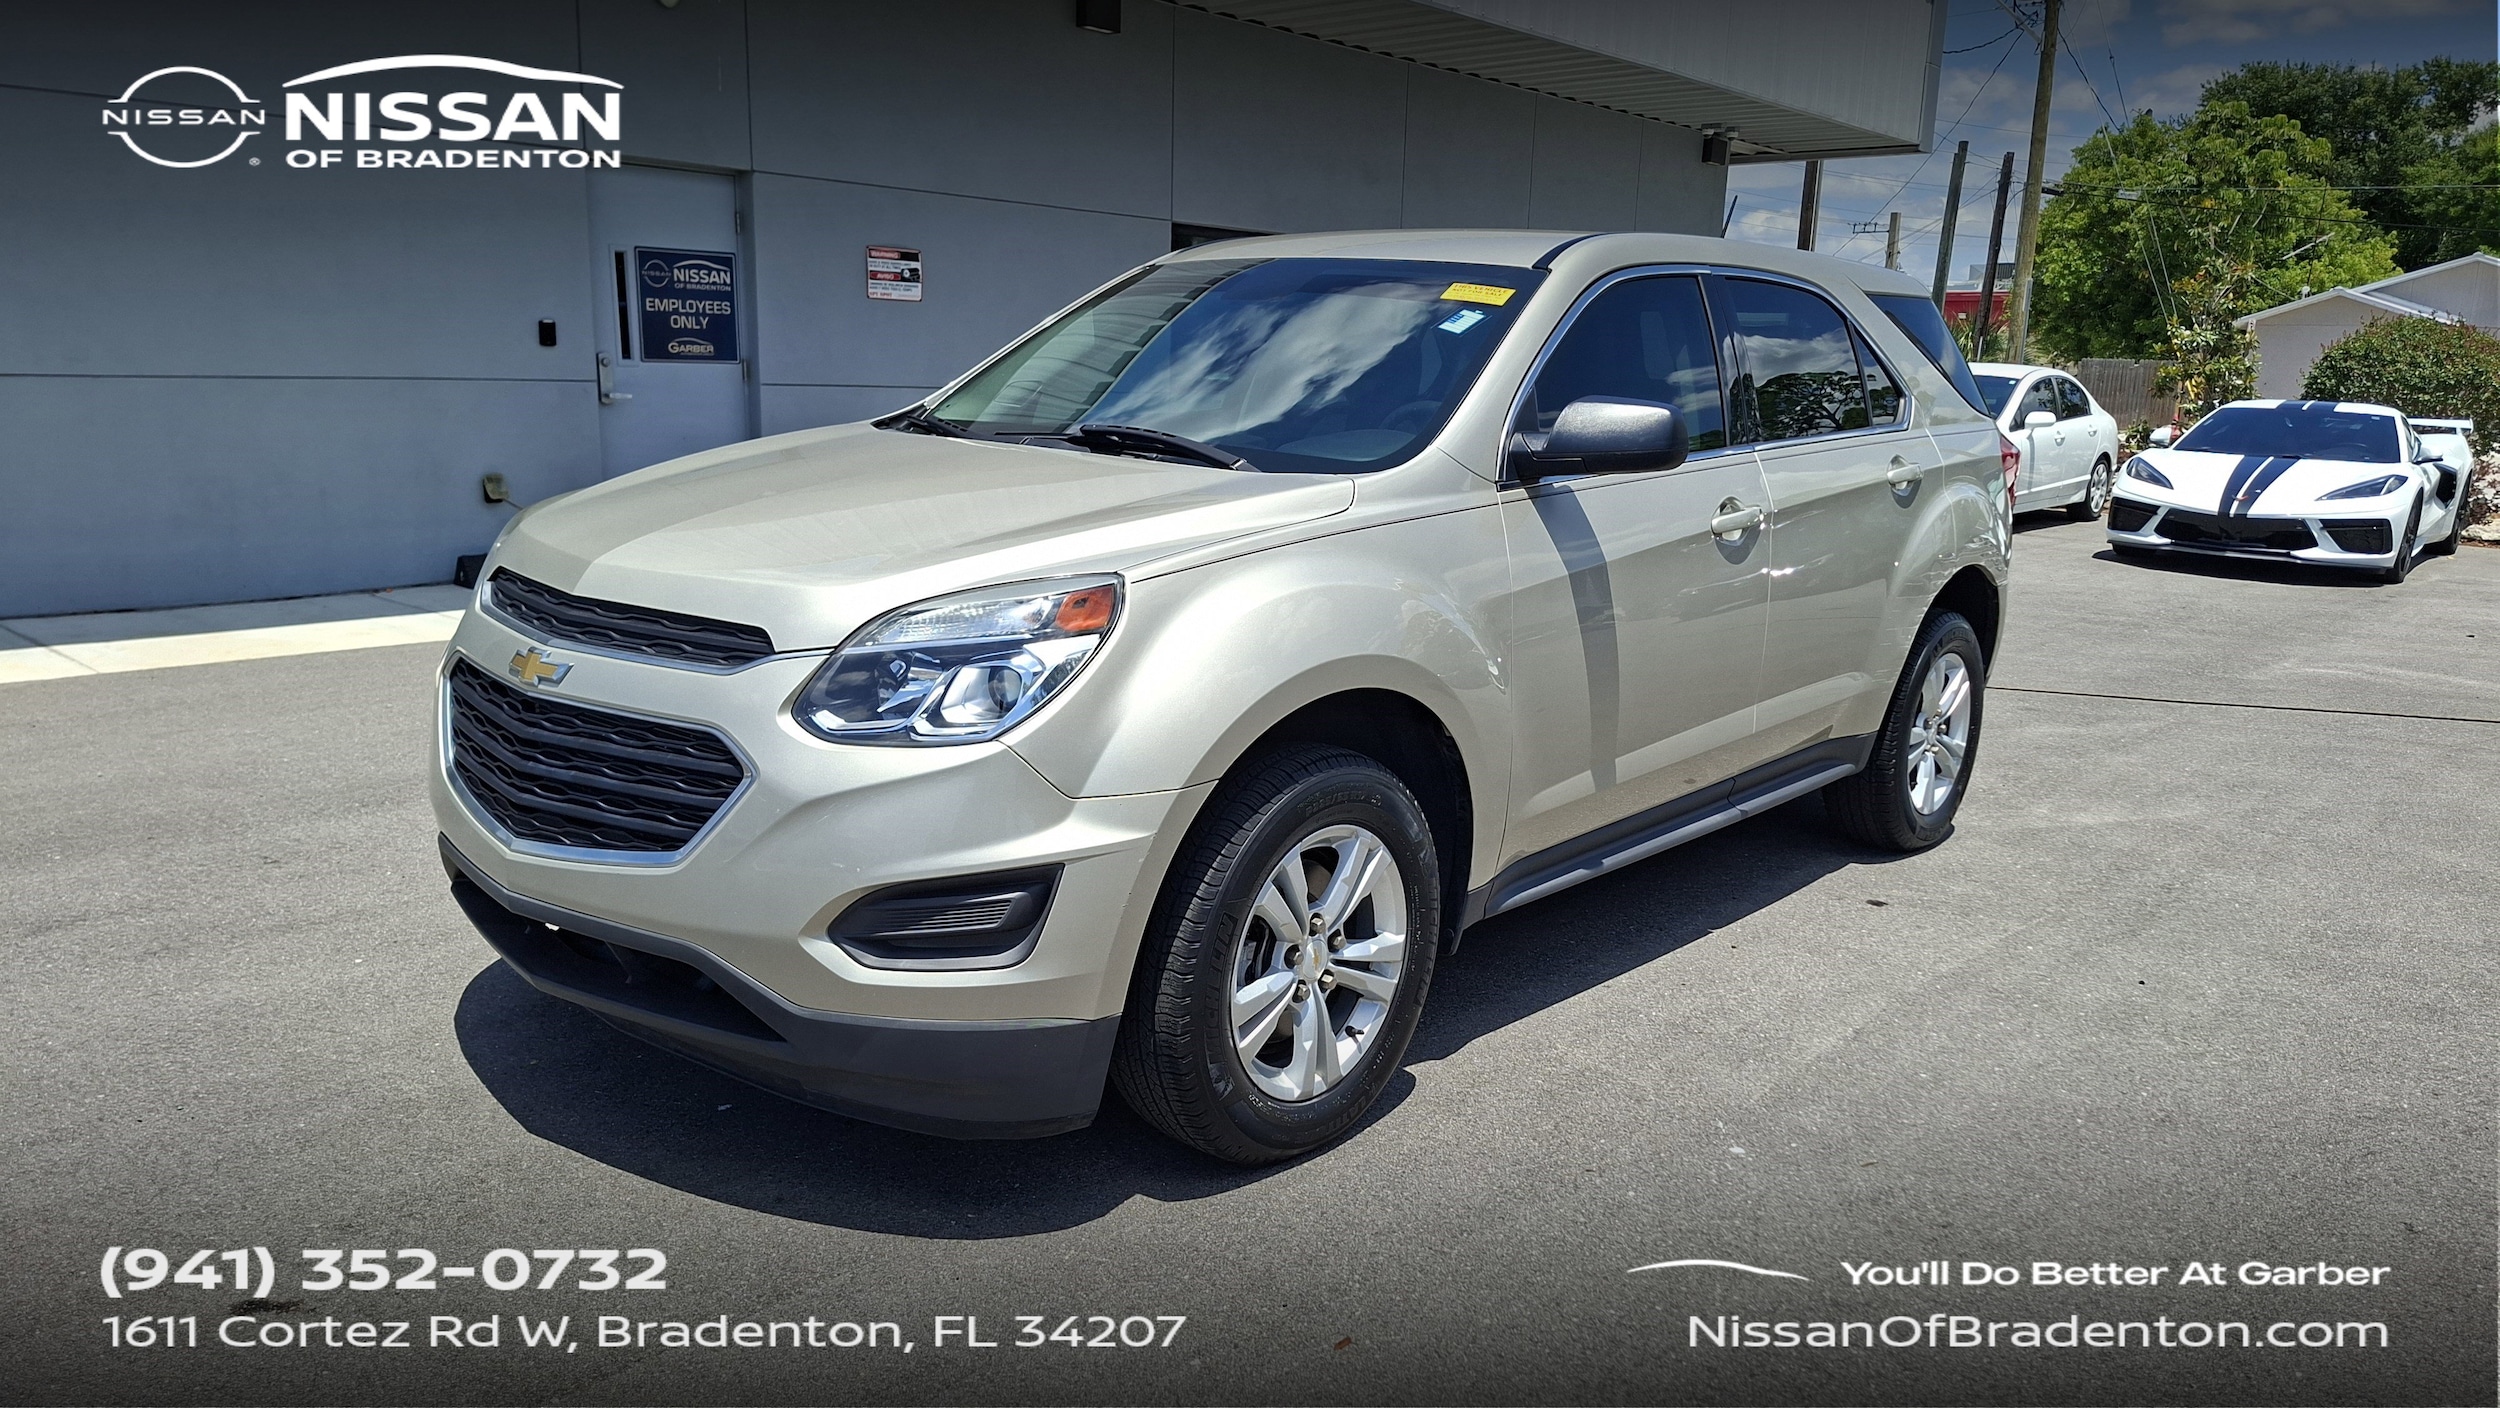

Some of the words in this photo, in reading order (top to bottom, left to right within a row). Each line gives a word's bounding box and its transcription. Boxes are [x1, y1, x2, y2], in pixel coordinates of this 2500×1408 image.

[673, 268, 731, 285] NISSAN
[686, 284, 731, 292] BRADENTON
[646, 298, 731, 315] EMPLOYEES
[670, 315, 709, 330] ONLY
[668, 342, 714, 354] GARBER
[1205, 911, 1236, 1063] MICHELIN
